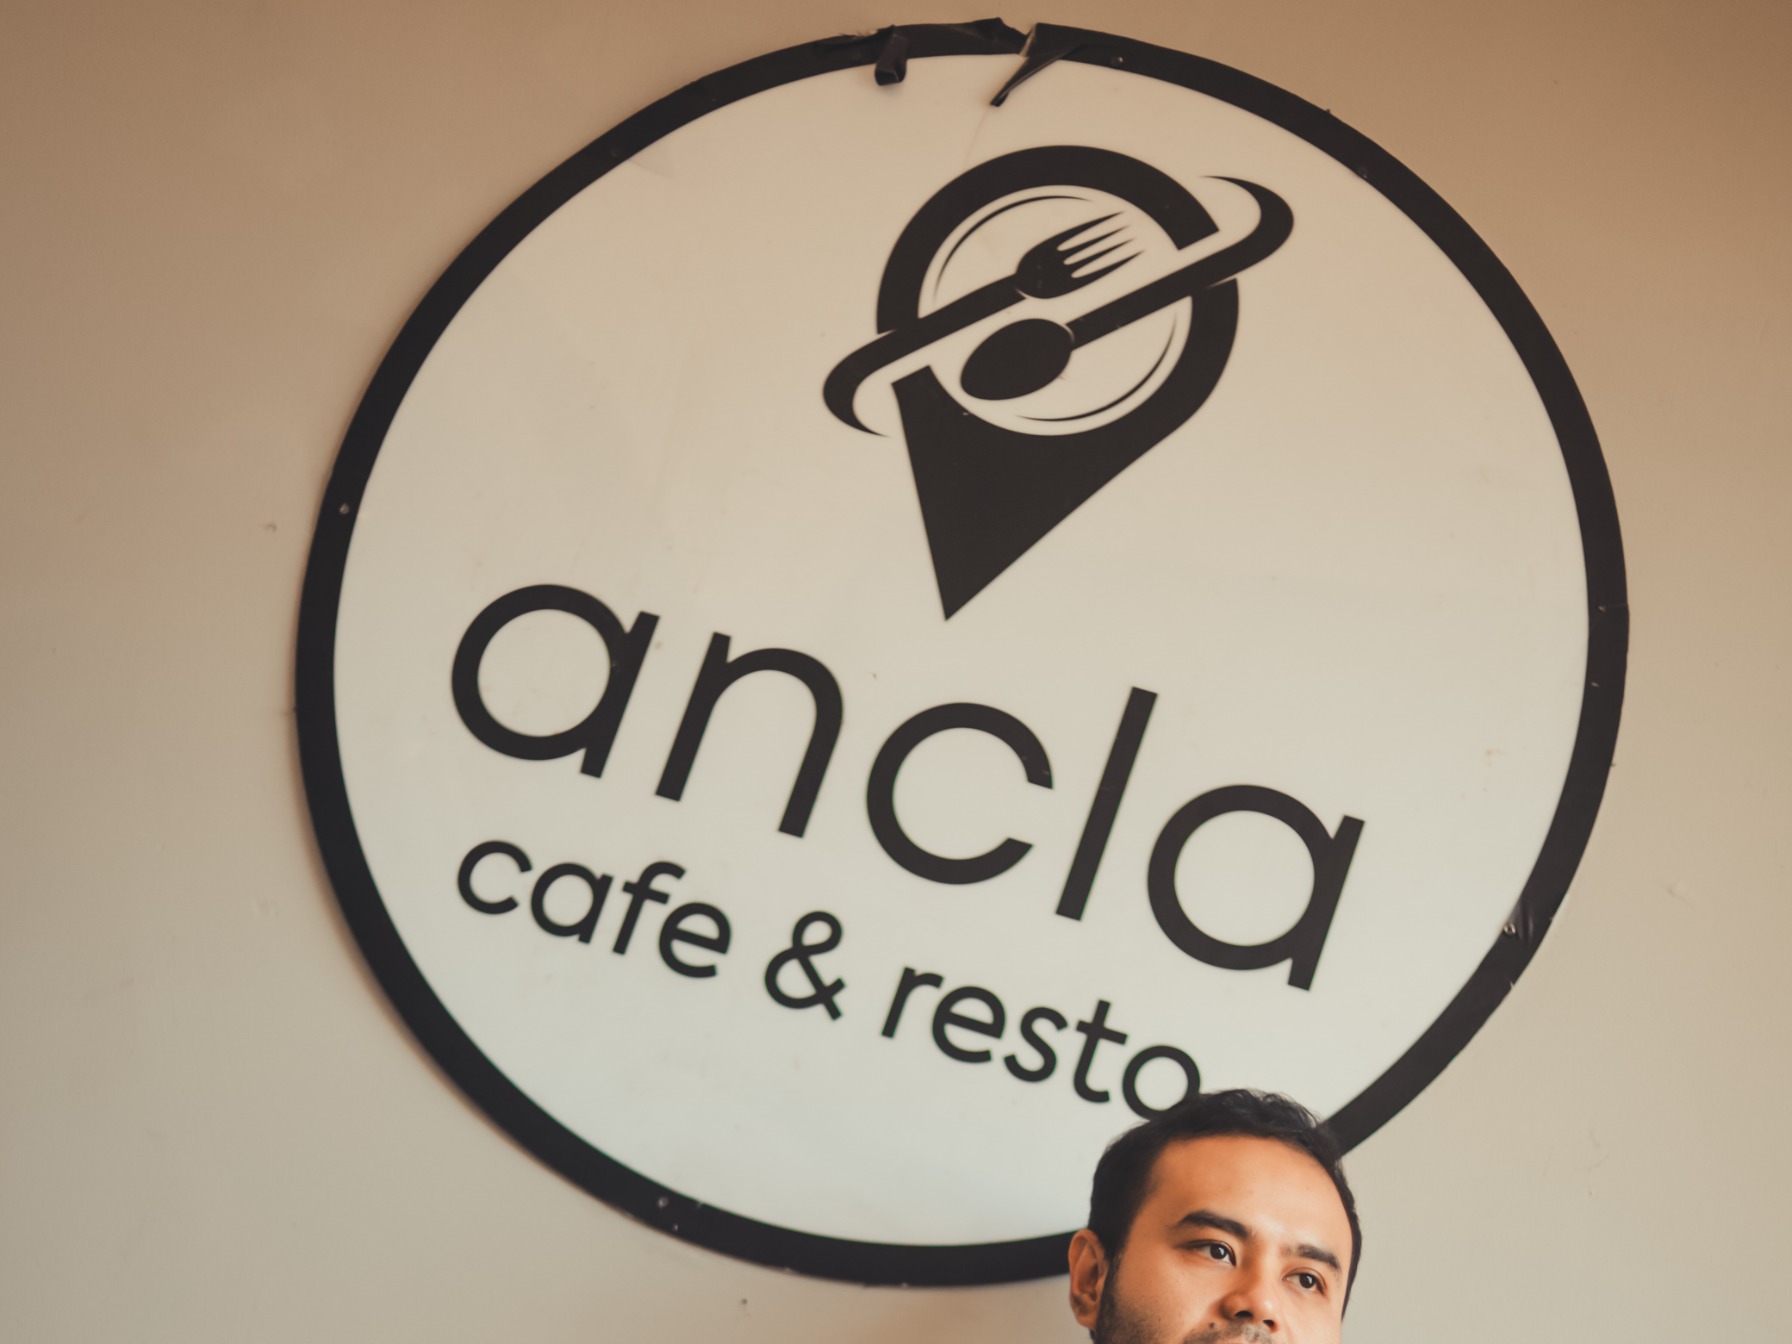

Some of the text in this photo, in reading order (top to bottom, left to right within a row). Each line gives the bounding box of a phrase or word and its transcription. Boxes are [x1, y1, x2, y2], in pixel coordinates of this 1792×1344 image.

[452, 584, 1365, 991] ancla
[457, 840, 1201, 1121] cafe & resto
